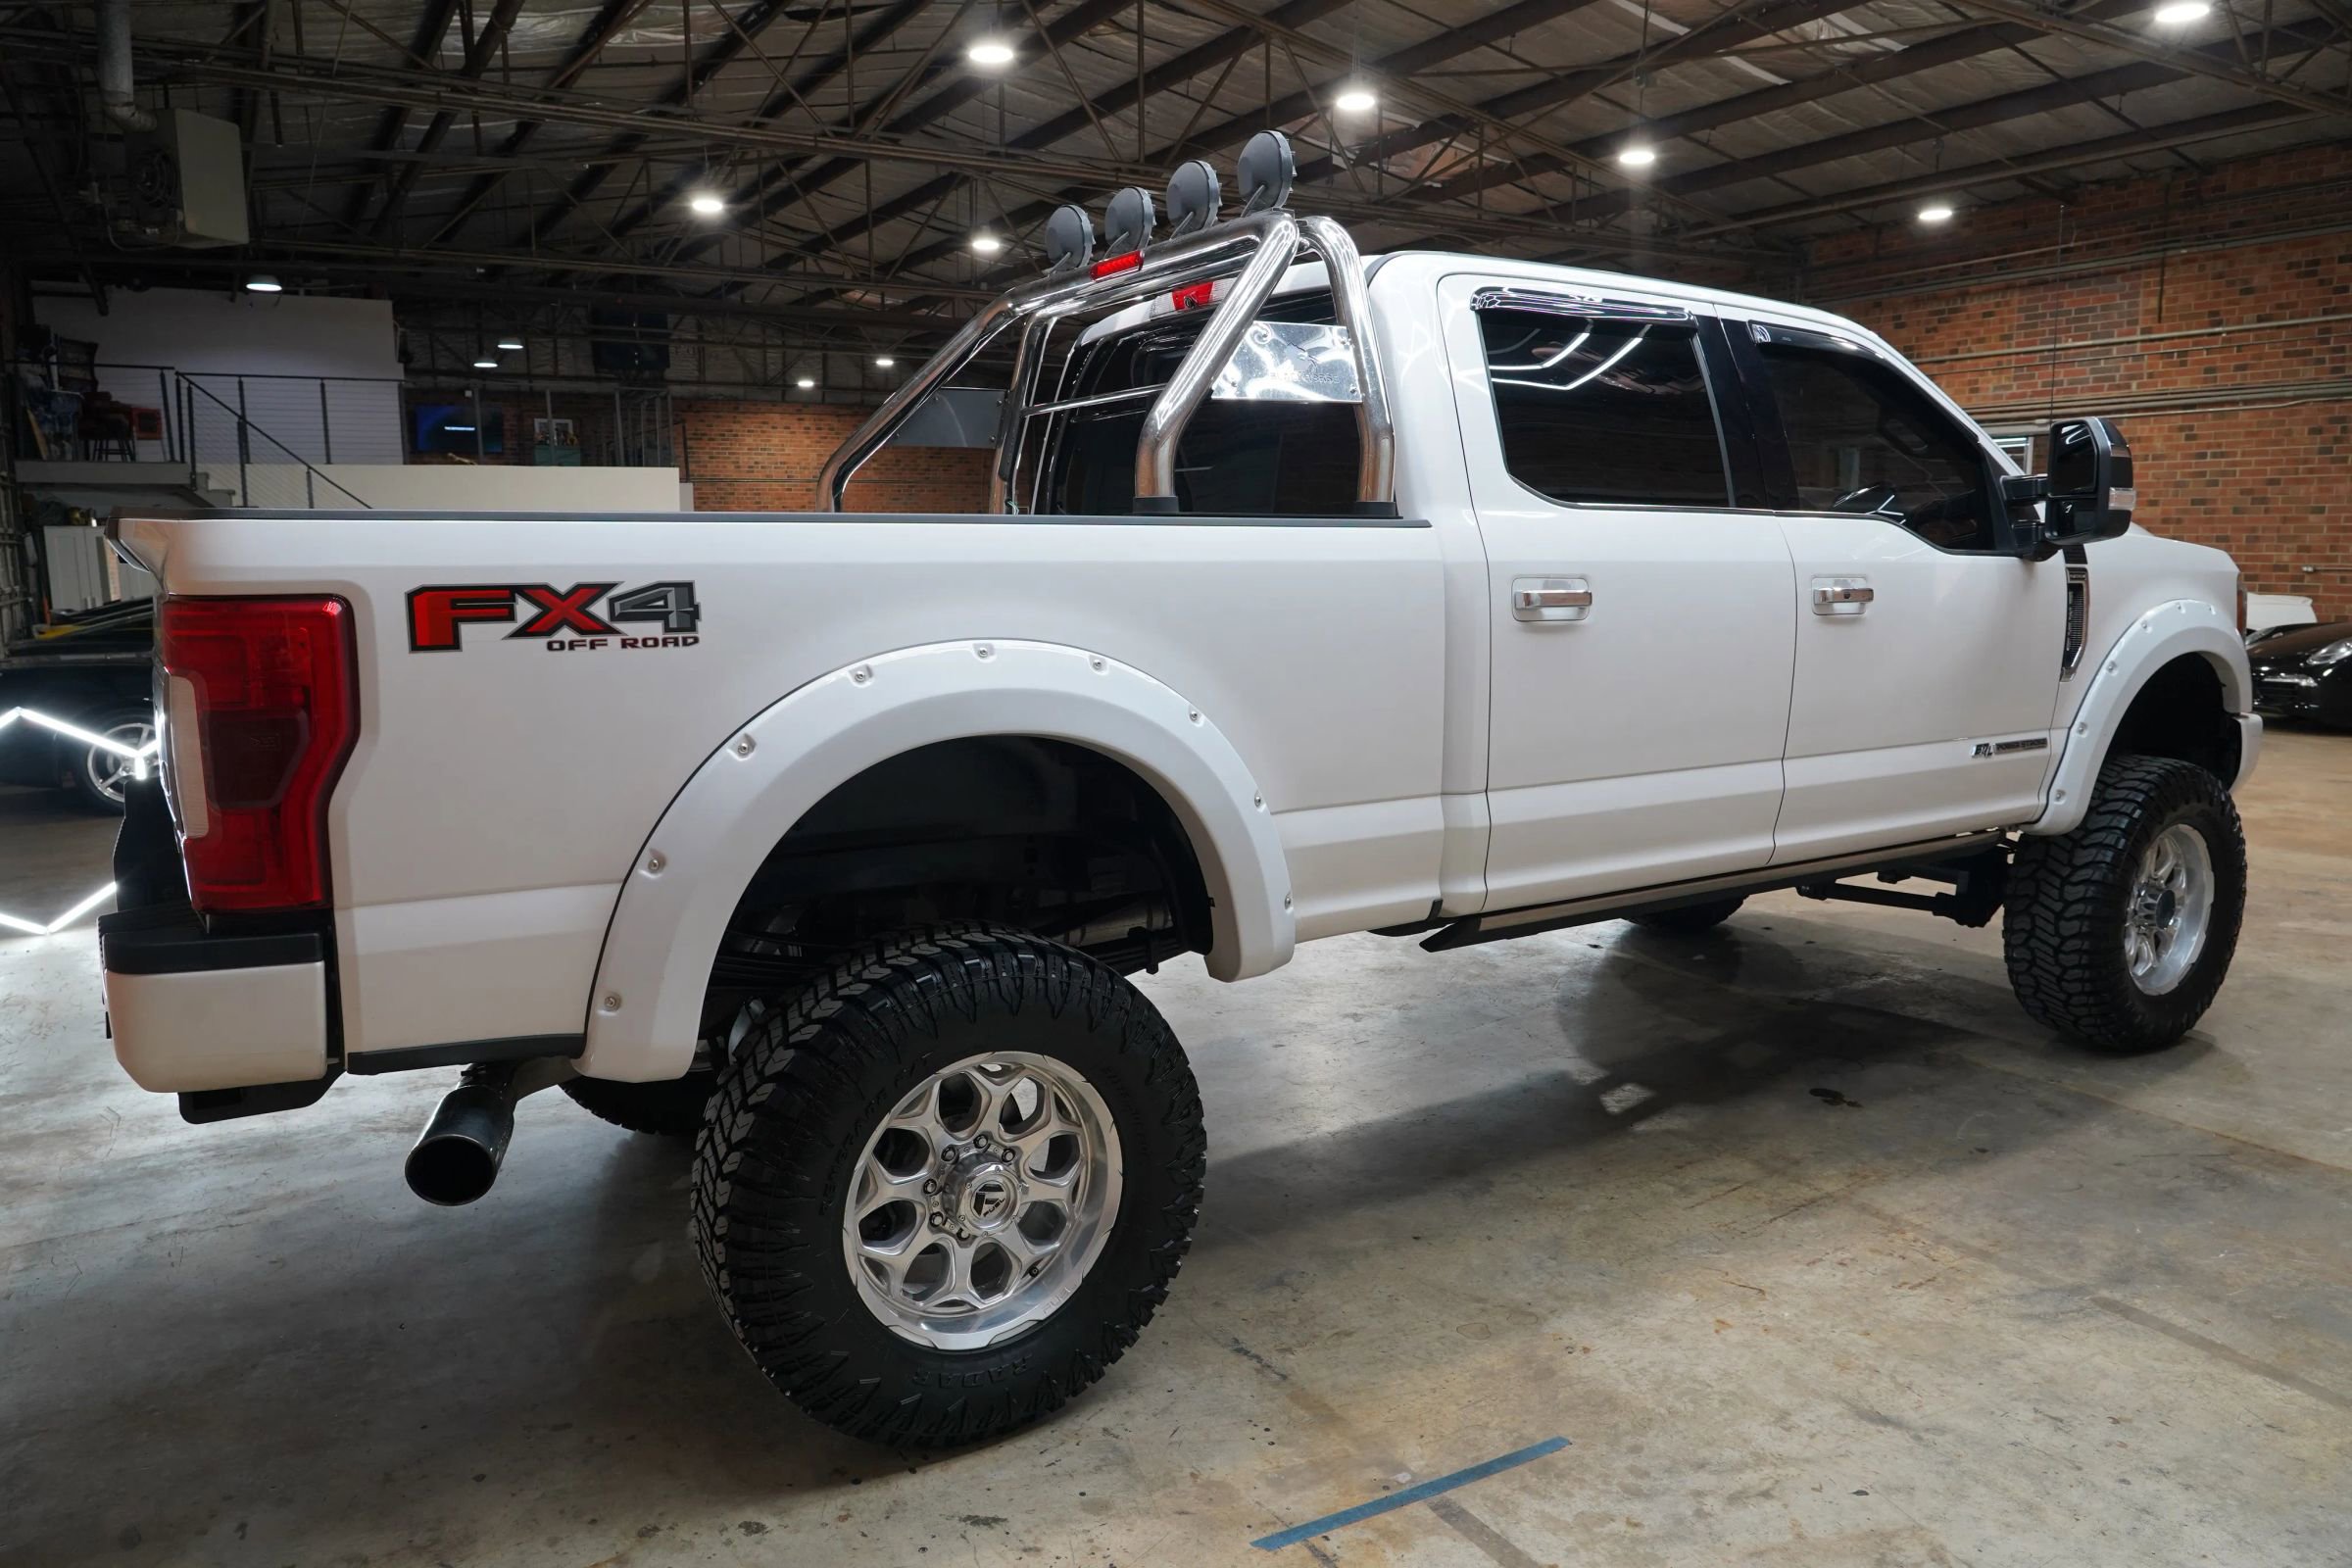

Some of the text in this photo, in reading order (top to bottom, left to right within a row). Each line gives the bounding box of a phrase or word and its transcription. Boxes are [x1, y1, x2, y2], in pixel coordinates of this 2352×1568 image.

[404, 580, 702, 654] FX4
[546, 636, 701, 652] OFF ROAD
[983, 1198, 1006, 1217] FUEL
[911, 1354, 1032, 1390] RADAR
